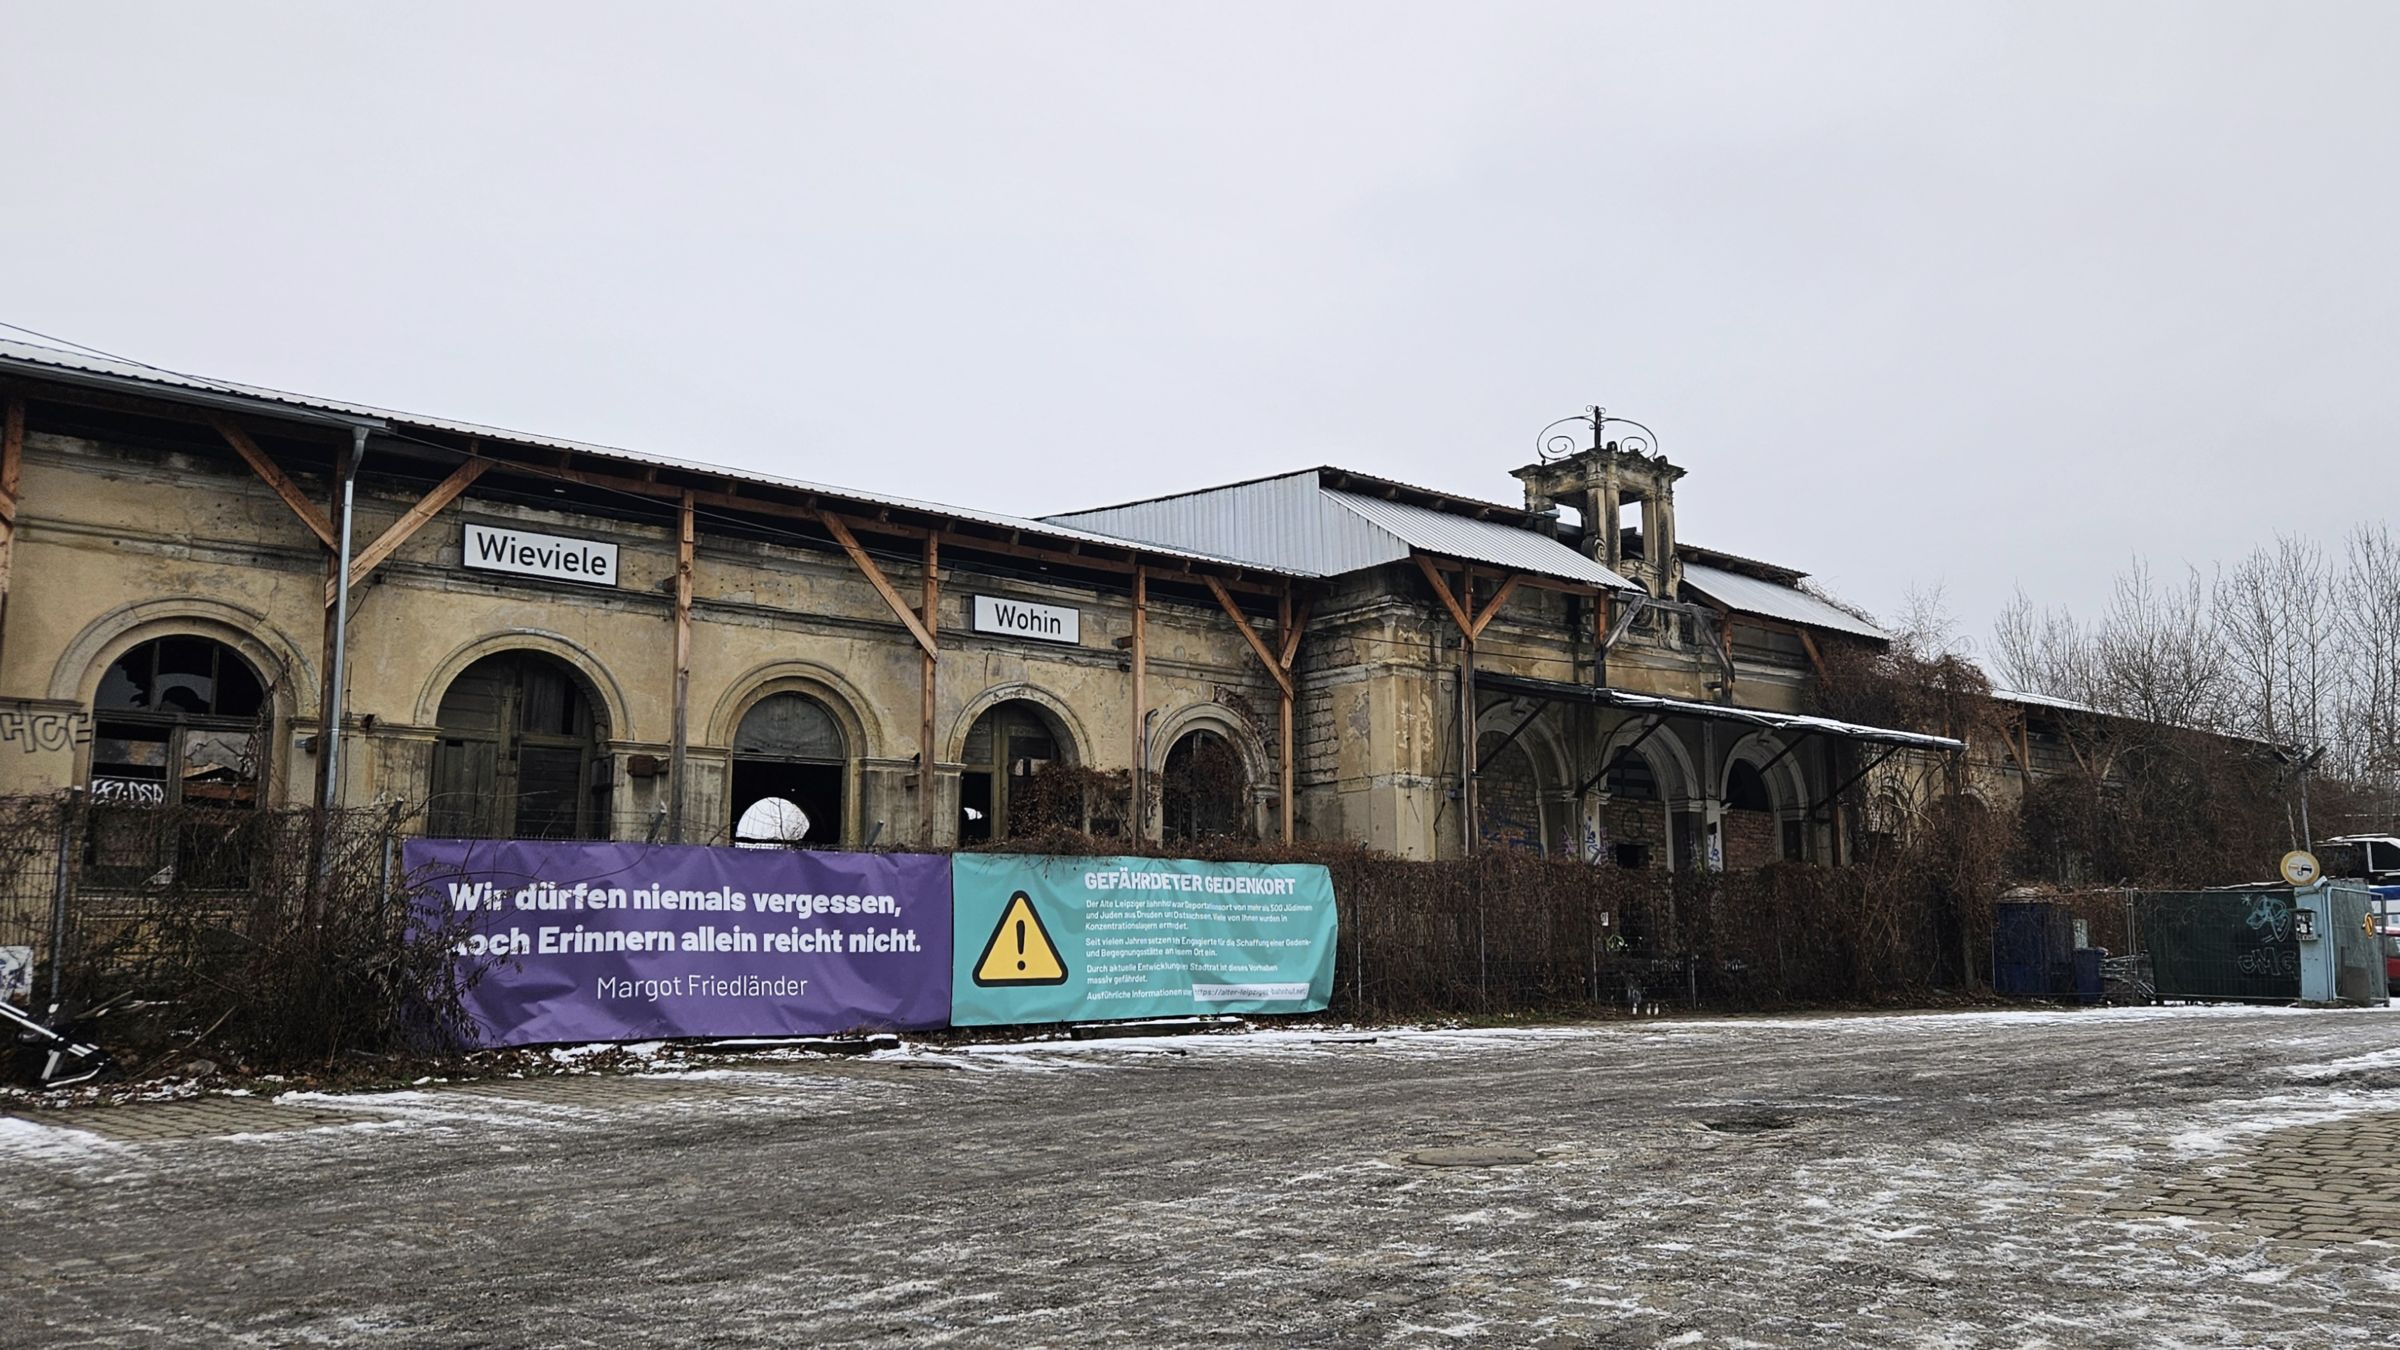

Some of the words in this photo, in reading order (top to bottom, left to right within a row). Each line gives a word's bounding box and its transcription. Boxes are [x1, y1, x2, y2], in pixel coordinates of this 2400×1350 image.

[477, 532, 607, 576] Wieviele
[994, 603, 1061, 634] Wohin
[1085, 867, 1203, 893] GEFÄHRDETER
[1205, 876, 1296, 895] GEDENKORT
[448, 882, 508, 911] Wir
[515, 881, 627, 911] dürfen
[633, 883, 746, 911] niemals
[752, 890, 902, 920] vergessen,
[1086, 899, 1098, 908] Der
[1099, 900, 1113, 908] Alte
[1115, 899, 1145, 910] Leipziger
[1270, 903, 1283, 912] 500
[1284, 903, 1312, 912] Jüdinnen
[1086, 911, 1099, 920] und
[1100, 911, 1123, 919] Juden
[1164, 911, 1173, 919] un
[1227, 914, 1241, 922] von
[1281, 914, 1288, 922] in
[1085, 921, 1157, 931] Konzentrationslagern
[452, 927, 530, 956] och
[538, 925, 675, 954] Erinnern
[681, 925, 757, 953] allein
[763, 926, 844, 953] reicht
[849, 927, 921, 953] nicht.
[1085, 937, 1100, 946] Seit
[1101, 937, 1123, 945] vielen
[1181, 937, 1217, 947] Engagierte
[1236, 938, 1270, 948] Schaffung
[1086, 949, 1100, 957] und
[1101, 948, 1163, 958] Begegnungsstätte
[1193, 948, 1204, 956] Ort
[1087, 964, 1108, 973] Durch
[1109, 963, 1137, 972] aktuelle
[1190, 962, 1219, 971] Stadtrat
[1228, 964, 1248, 972] dieses
[1087, 975, 1113, 984] massiv
[1114, 974, 1148, 985] gefährdet.
[597, 976, 683, 1002] Margot
[688, 974, 808, 997] Friedländer
[1087, 989, 1131, 1000] Ausführliche
[1131, 988, 1182, 998] Informationen
